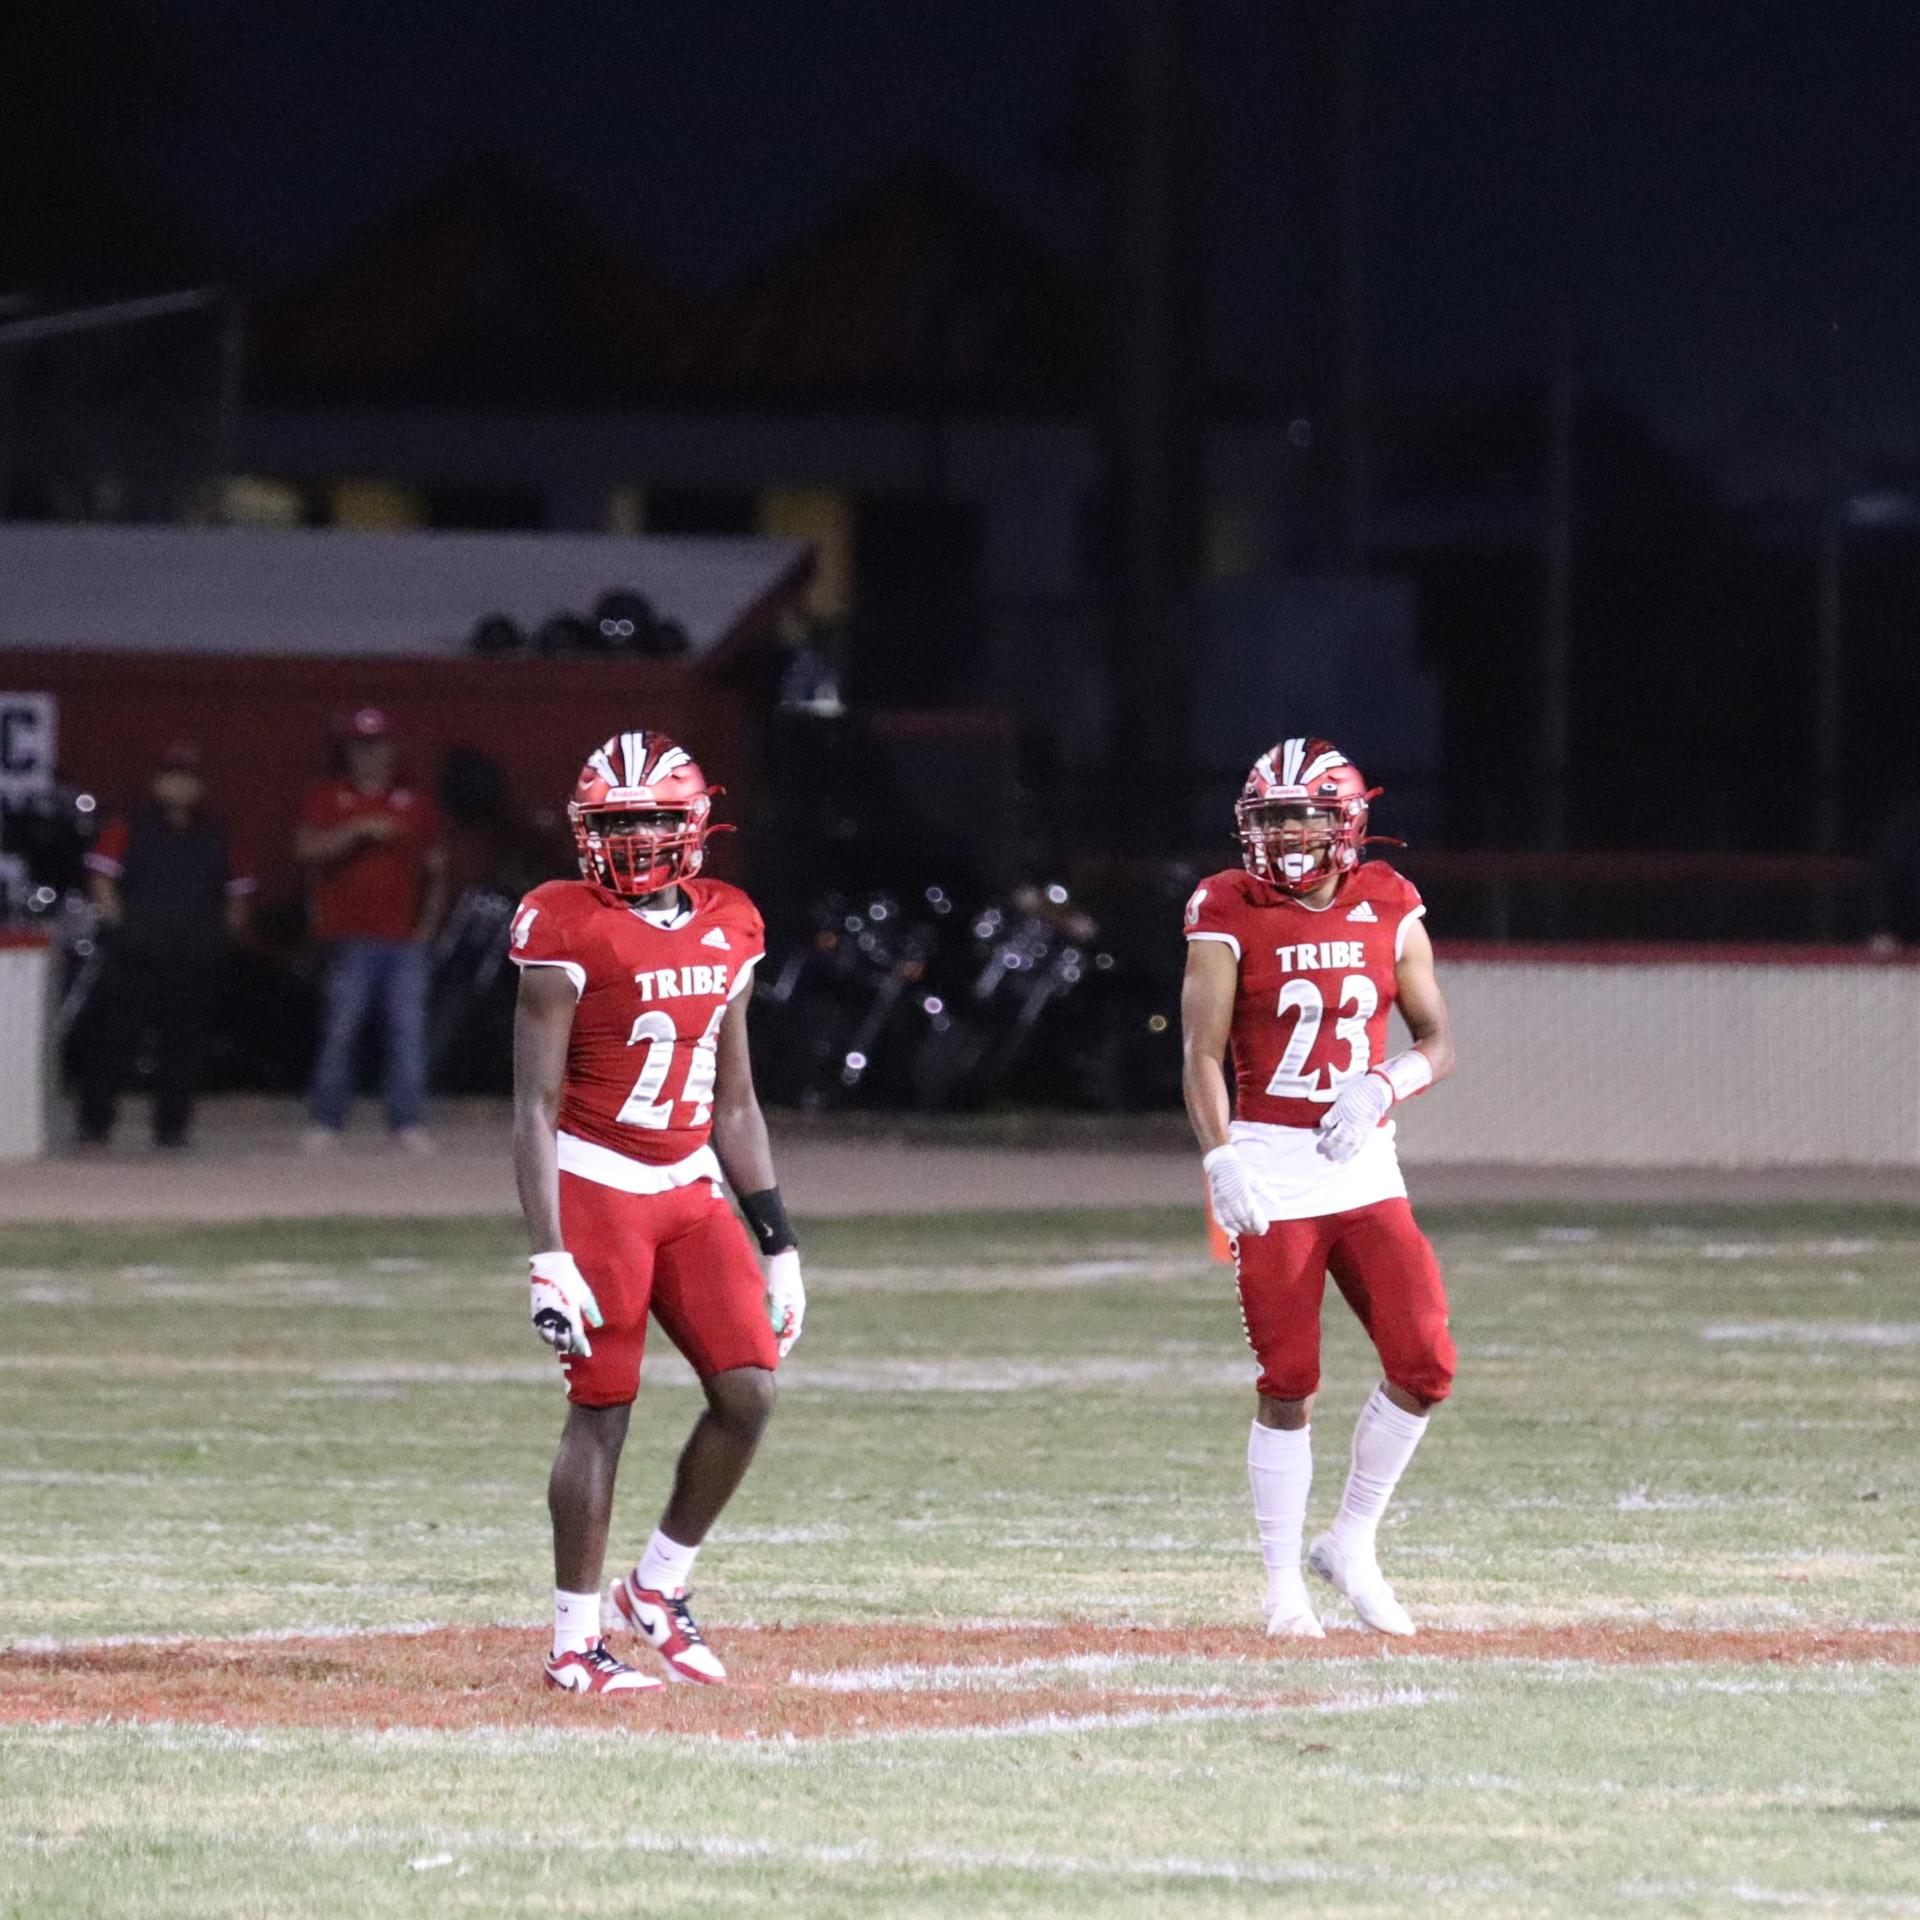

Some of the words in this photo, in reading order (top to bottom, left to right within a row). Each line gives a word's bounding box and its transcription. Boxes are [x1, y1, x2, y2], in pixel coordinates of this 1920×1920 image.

[1276, 941, 1366, 973] TRIBE
[635, 965, 728, 1002] TRIBE
[1265, 974, 1378, 1103] 23
